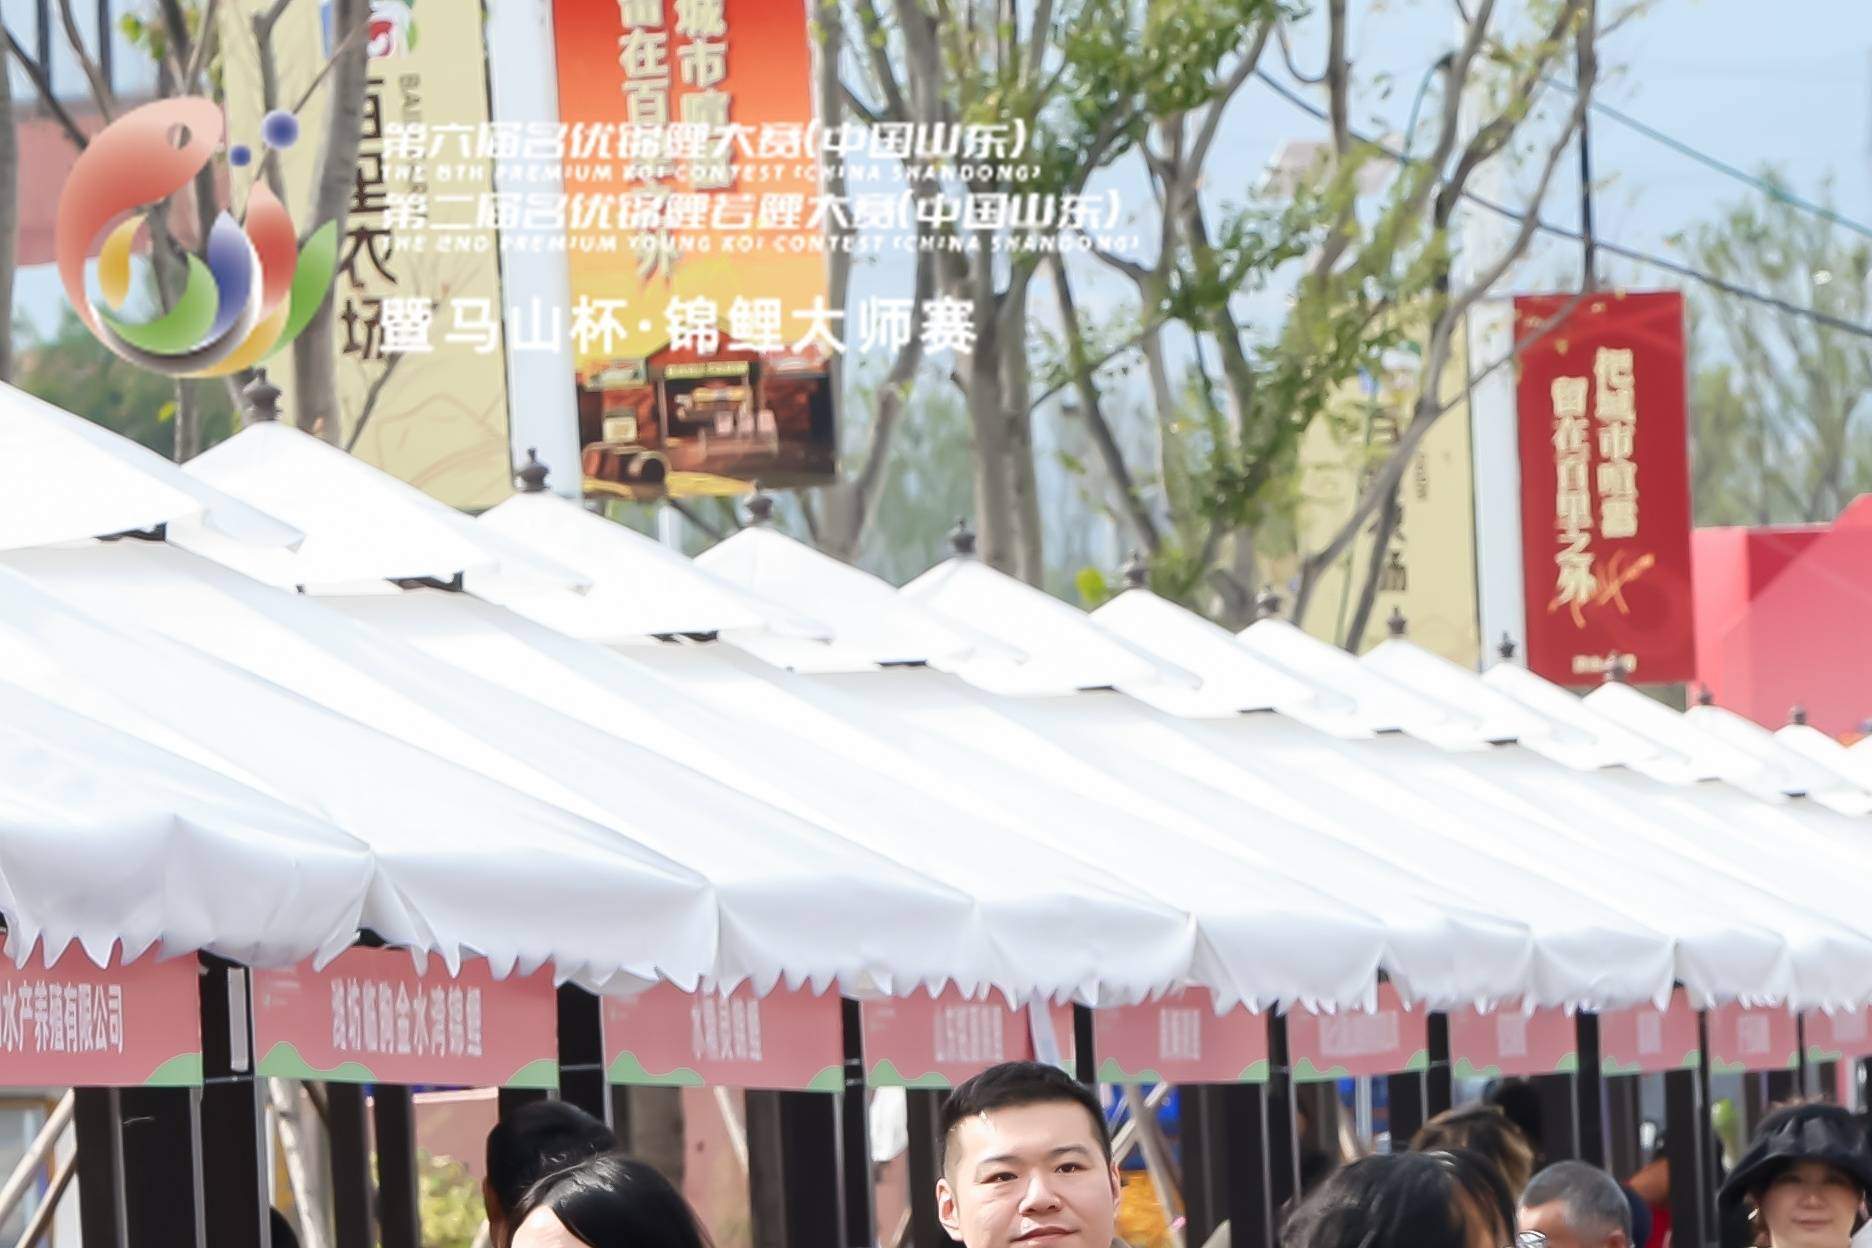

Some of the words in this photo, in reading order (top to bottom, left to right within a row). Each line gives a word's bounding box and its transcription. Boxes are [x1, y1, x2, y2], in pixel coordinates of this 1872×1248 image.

[0, 978, 124, 1054] 水产养殖有限公司
